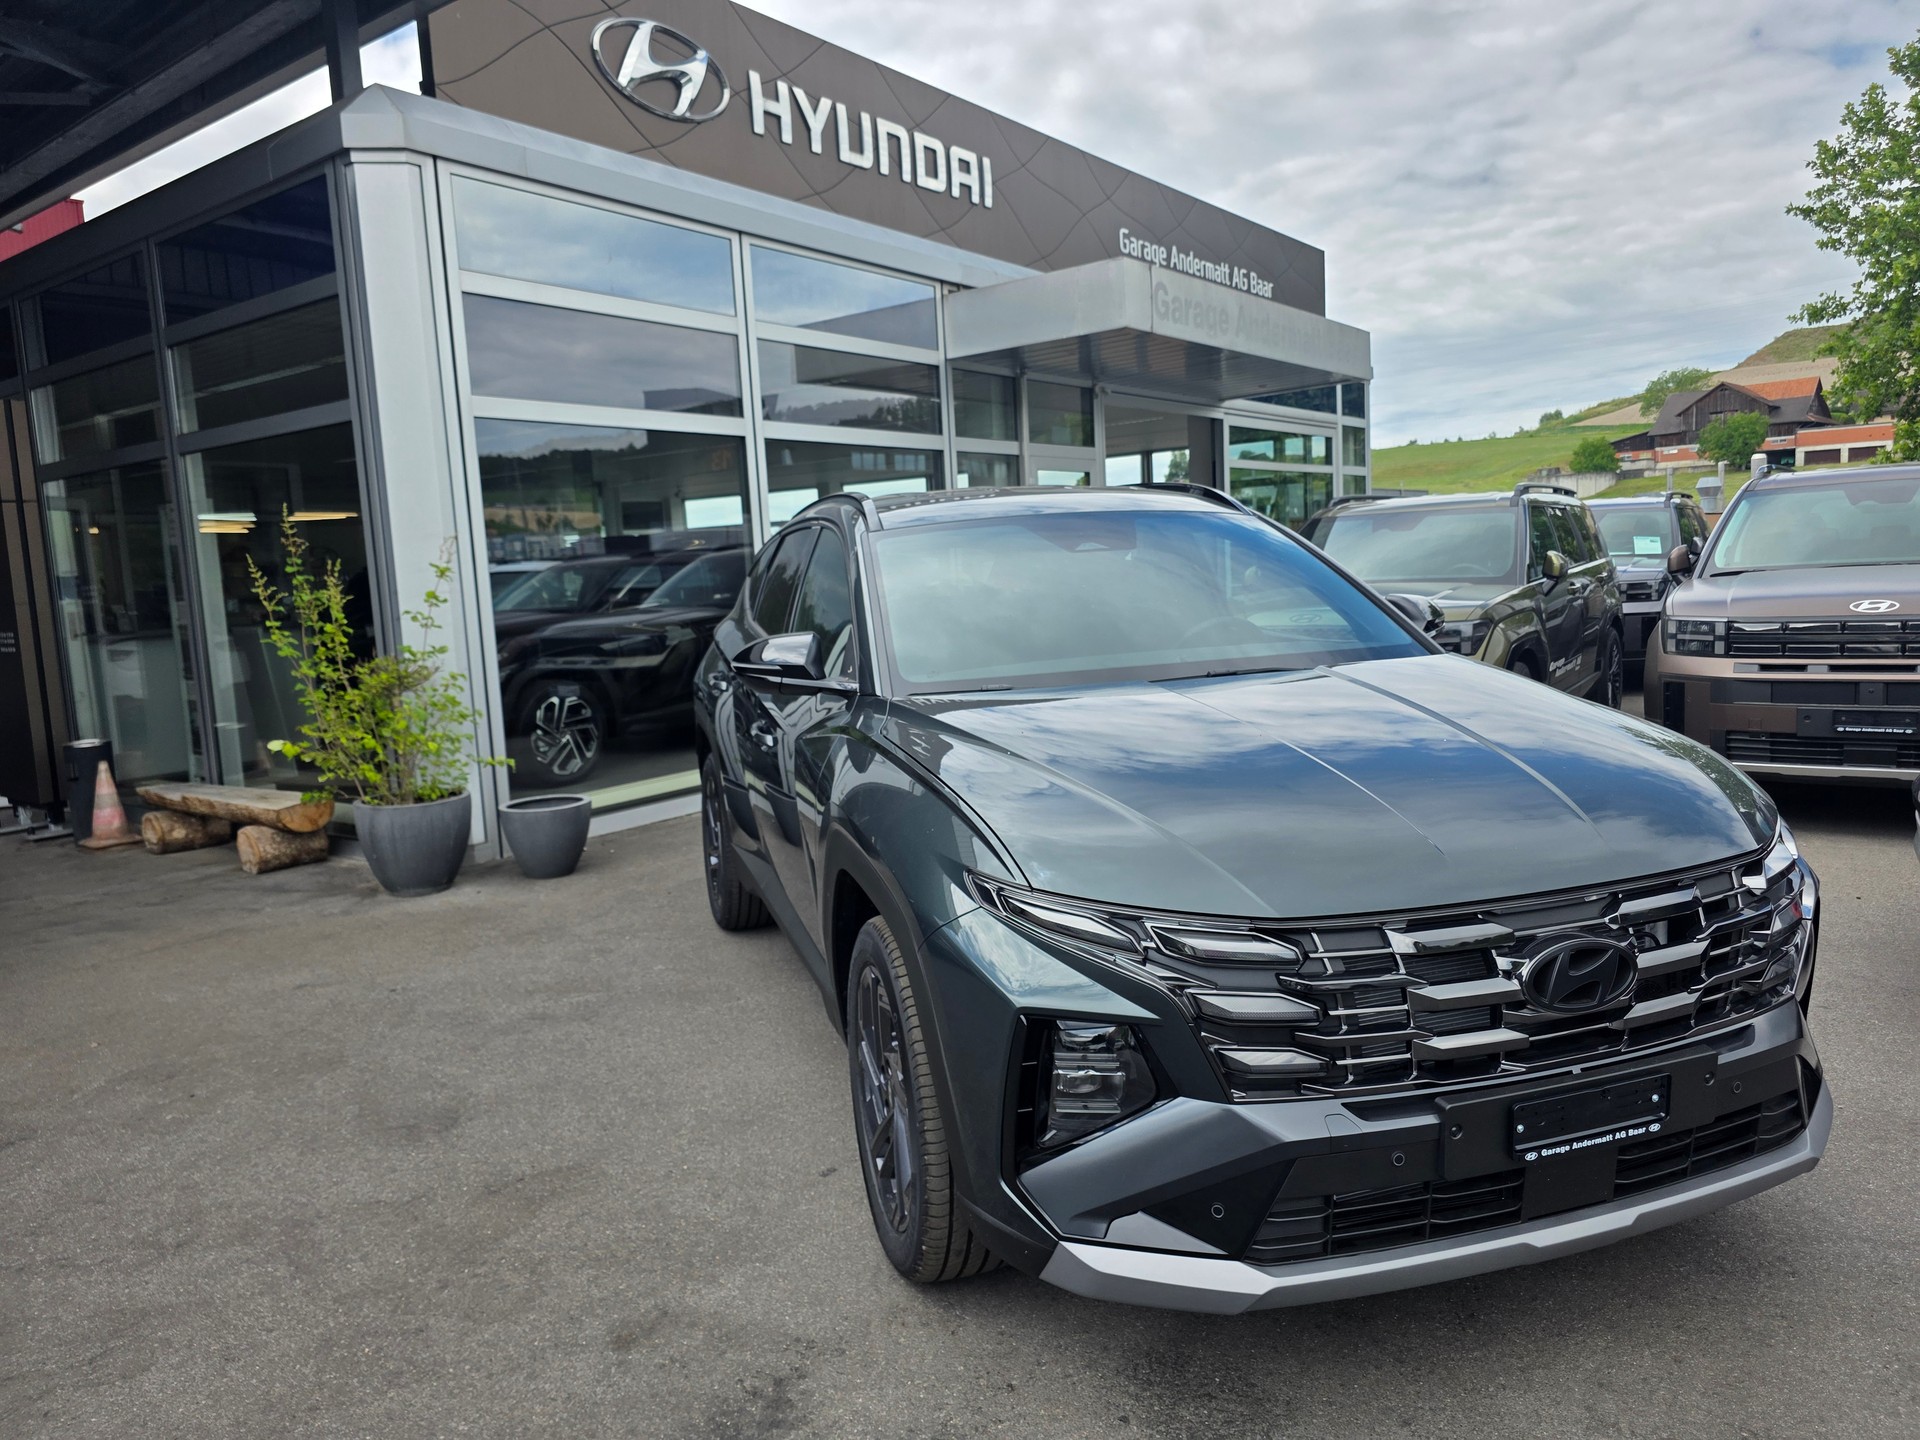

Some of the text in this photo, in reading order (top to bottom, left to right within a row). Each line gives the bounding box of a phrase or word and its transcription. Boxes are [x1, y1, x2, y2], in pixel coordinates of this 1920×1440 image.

[747, 69, 994, 208] HYUNDAI
[1119, 228, 1274, 299] Garage Andermatt AG Baar
[1153, 280, 1230, 335] Garage
[1541, 1126, 1646, 1157] Garage Andermatt AG Baar
